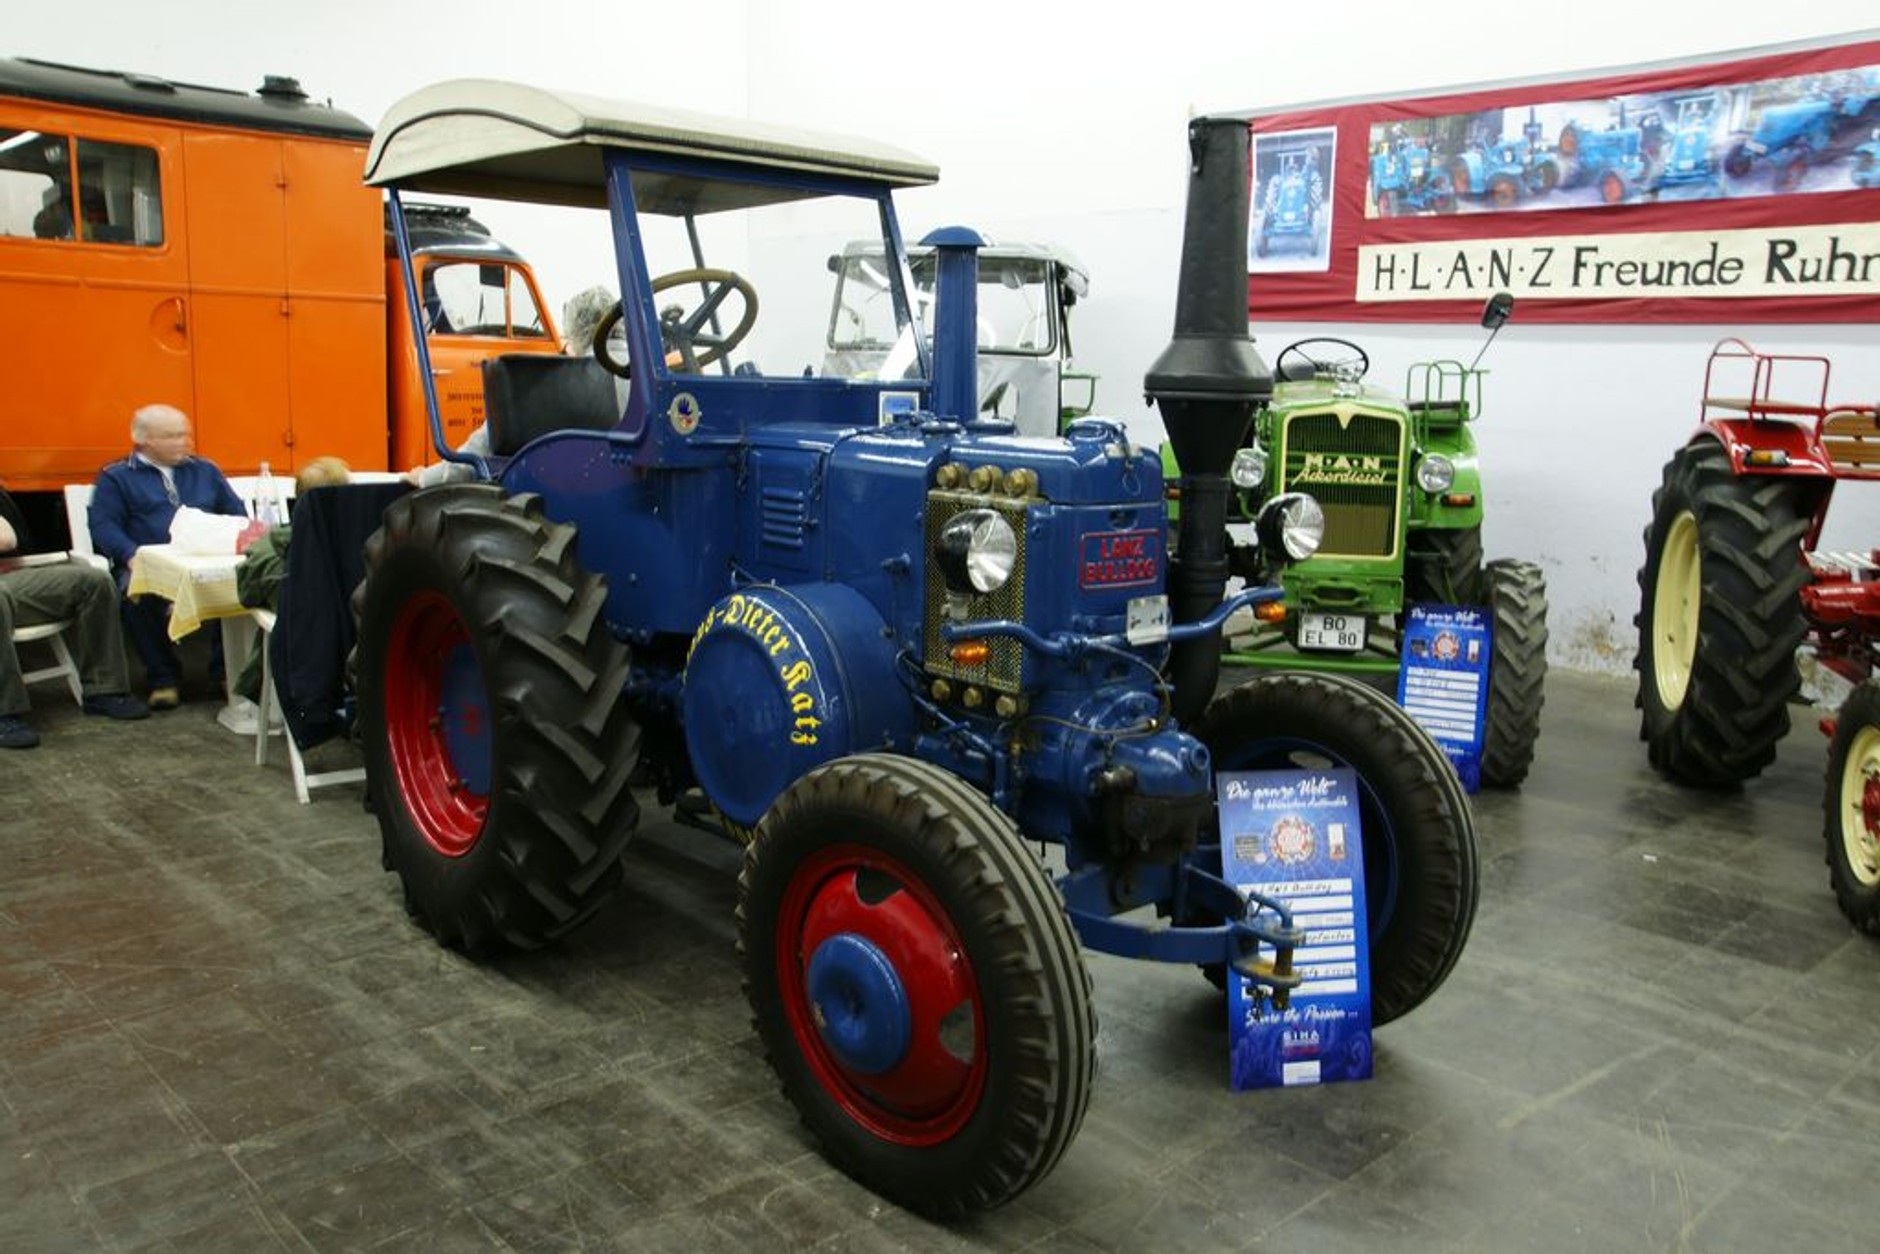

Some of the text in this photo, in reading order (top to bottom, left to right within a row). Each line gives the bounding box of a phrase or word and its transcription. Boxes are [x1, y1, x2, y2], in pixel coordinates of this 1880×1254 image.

[1572, 241, 1743, 287] Freunde
[1291, 467, 1388, 486] Ackerdiesel
[1101, 536, 1145, 559] LANZ
[1086, 558, 1155, 583] BULLDOG
[1323, 616, 1347, 631] BO
[1305, 630, 1358, 646] EL 80
[1226, 779, 1251, 799] Die
[1297, 776, 1337, 796] Welt
[1304, 1003, 1346, 1021] Passion
